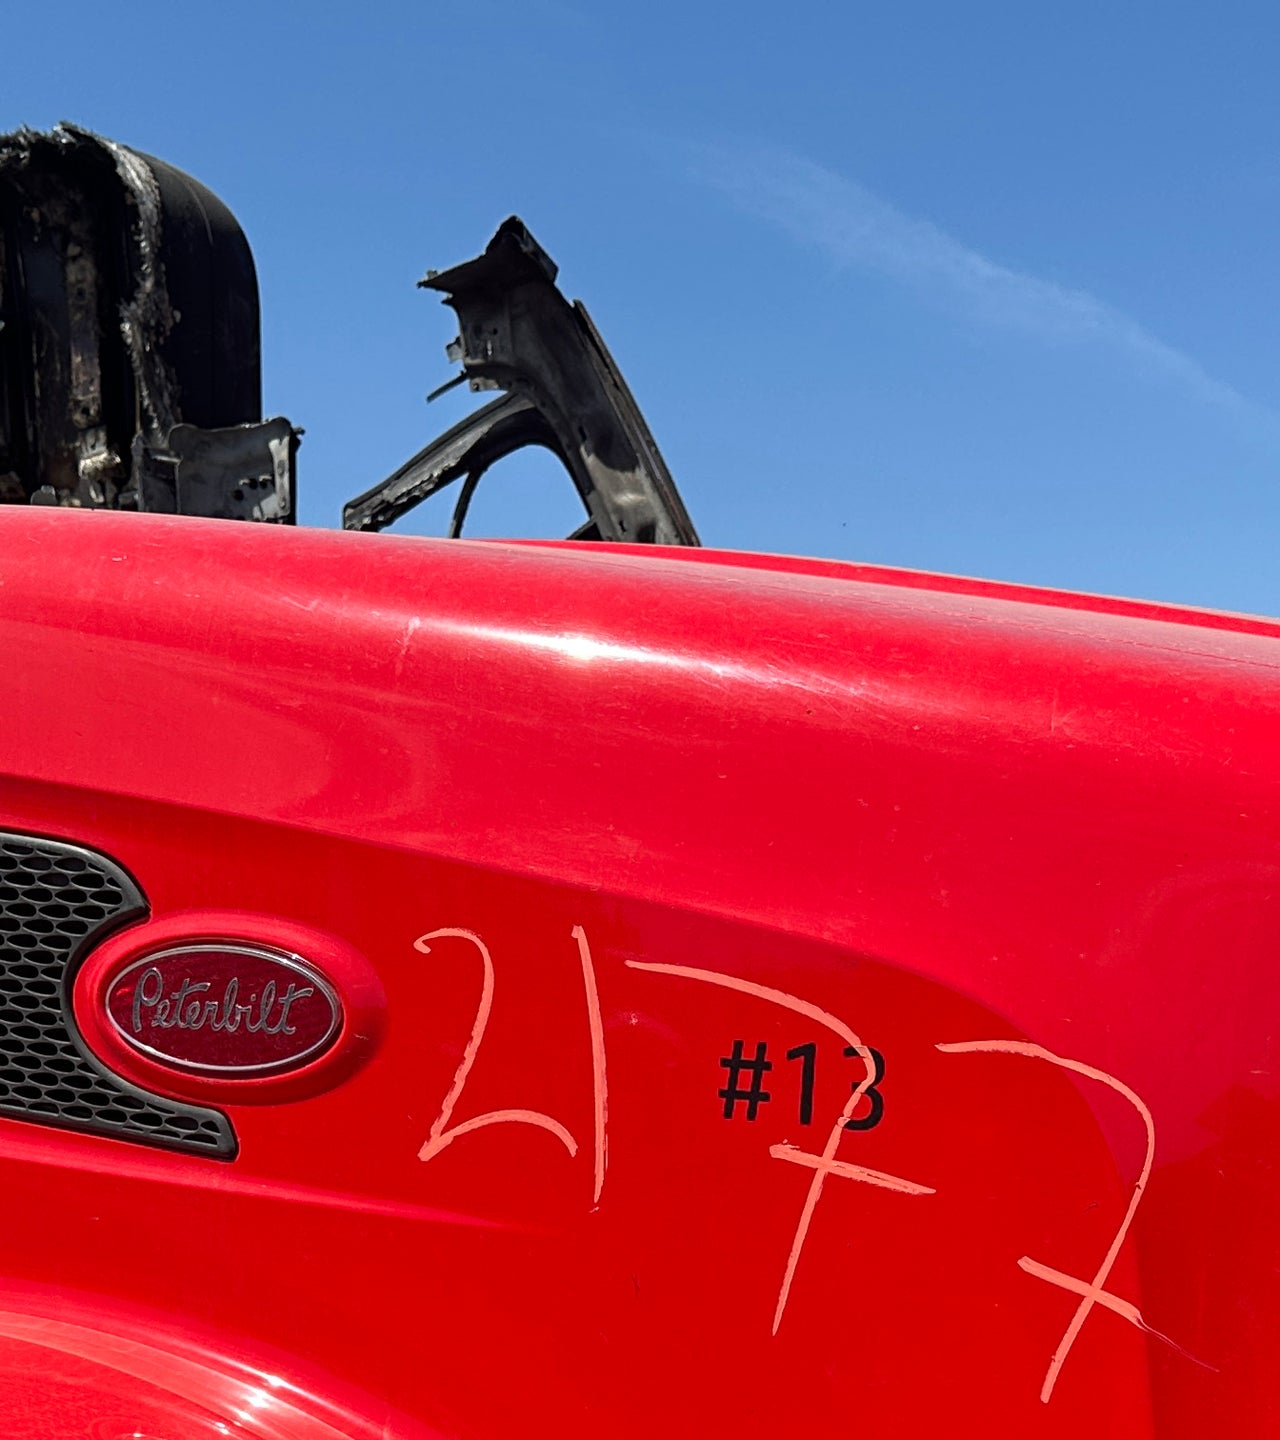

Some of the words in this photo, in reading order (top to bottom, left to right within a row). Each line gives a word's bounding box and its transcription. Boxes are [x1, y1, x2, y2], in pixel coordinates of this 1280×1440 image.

[131, 966, 314, 1035] Peterbilt
[718, 1039, 885, 1131] #13
[414, 925, 1156, 1404] 2177
